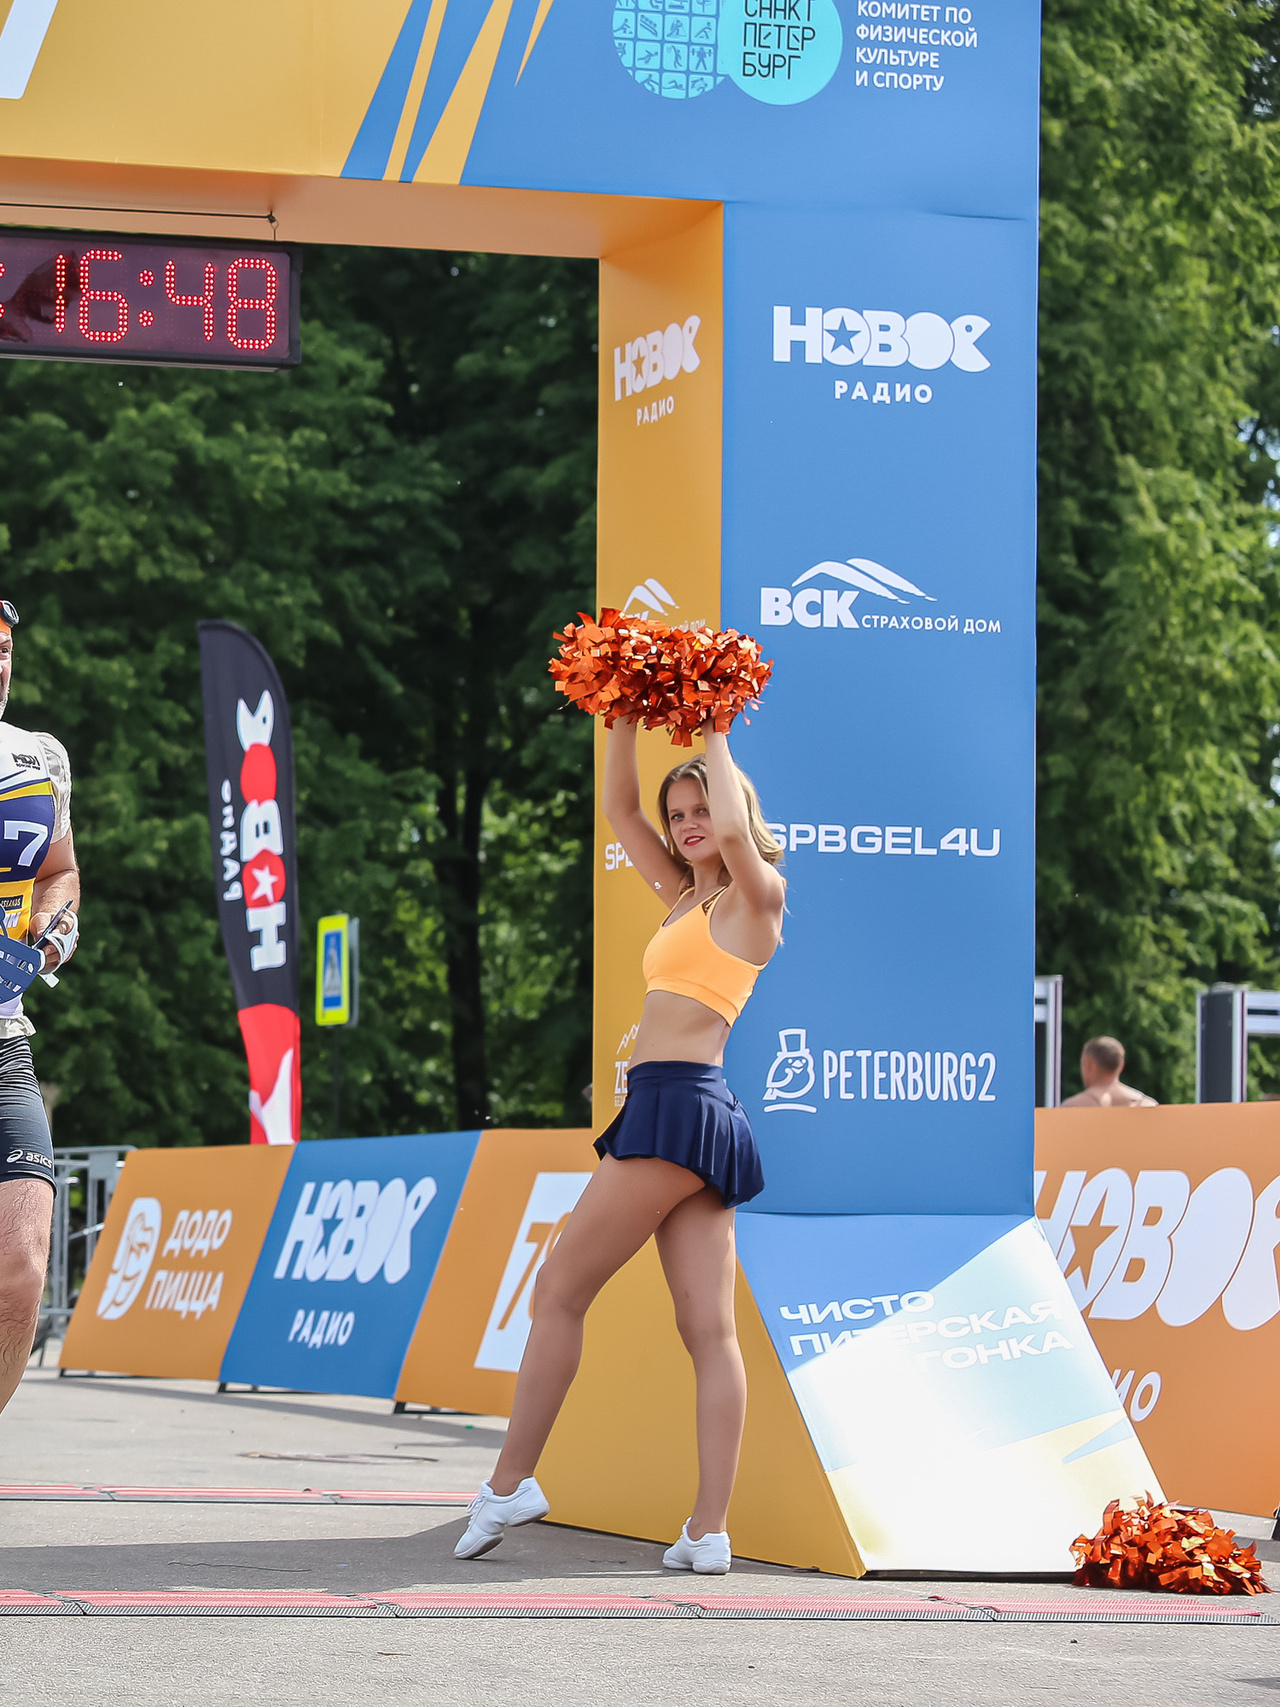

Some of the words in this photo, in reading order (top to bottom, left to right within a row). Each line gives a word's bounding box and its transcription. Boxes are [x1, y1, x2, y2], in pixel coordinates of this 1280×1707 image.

[857, 0, 940, 23] КОМИТЕТ
[945, 6, 972, 25] ПО
[743, 22, 816, 51] ПЕТЕР
[856, 23, 978, 48] ФИЗИЧЕСКОЙ
[742, 52, 801, 80] БУРГ
[856, 47, 939, 69] КУЛЬТУРЕ
[856, 70, 868, 87] И
[873, 71, 944, 92] СПОРТУ
[834, 380, 933, 404] РАДИО
[637, 396, 675, 426] РАДИО
[761, 587, 860, 628] ВСК
[862, 615, 959, 632] СТРАХОВОЙ
[963, 618, 1001, 634] ДОМ
[766, 822, 1000, 857] SPBGEL4U
[823, 1049, 996, 1102] PETERBURG2
[26, 1152, 53, 1169] asics
[162, 1209, 233, 1258] ДОДО
[497, 1211, 571, 1331] 7
[144, 1269, 224, 1319] ПИЦЦА
[779, 1291, 935, 1325] ЧИСТО
[288, 1309, 355, 1348] РАДИО
